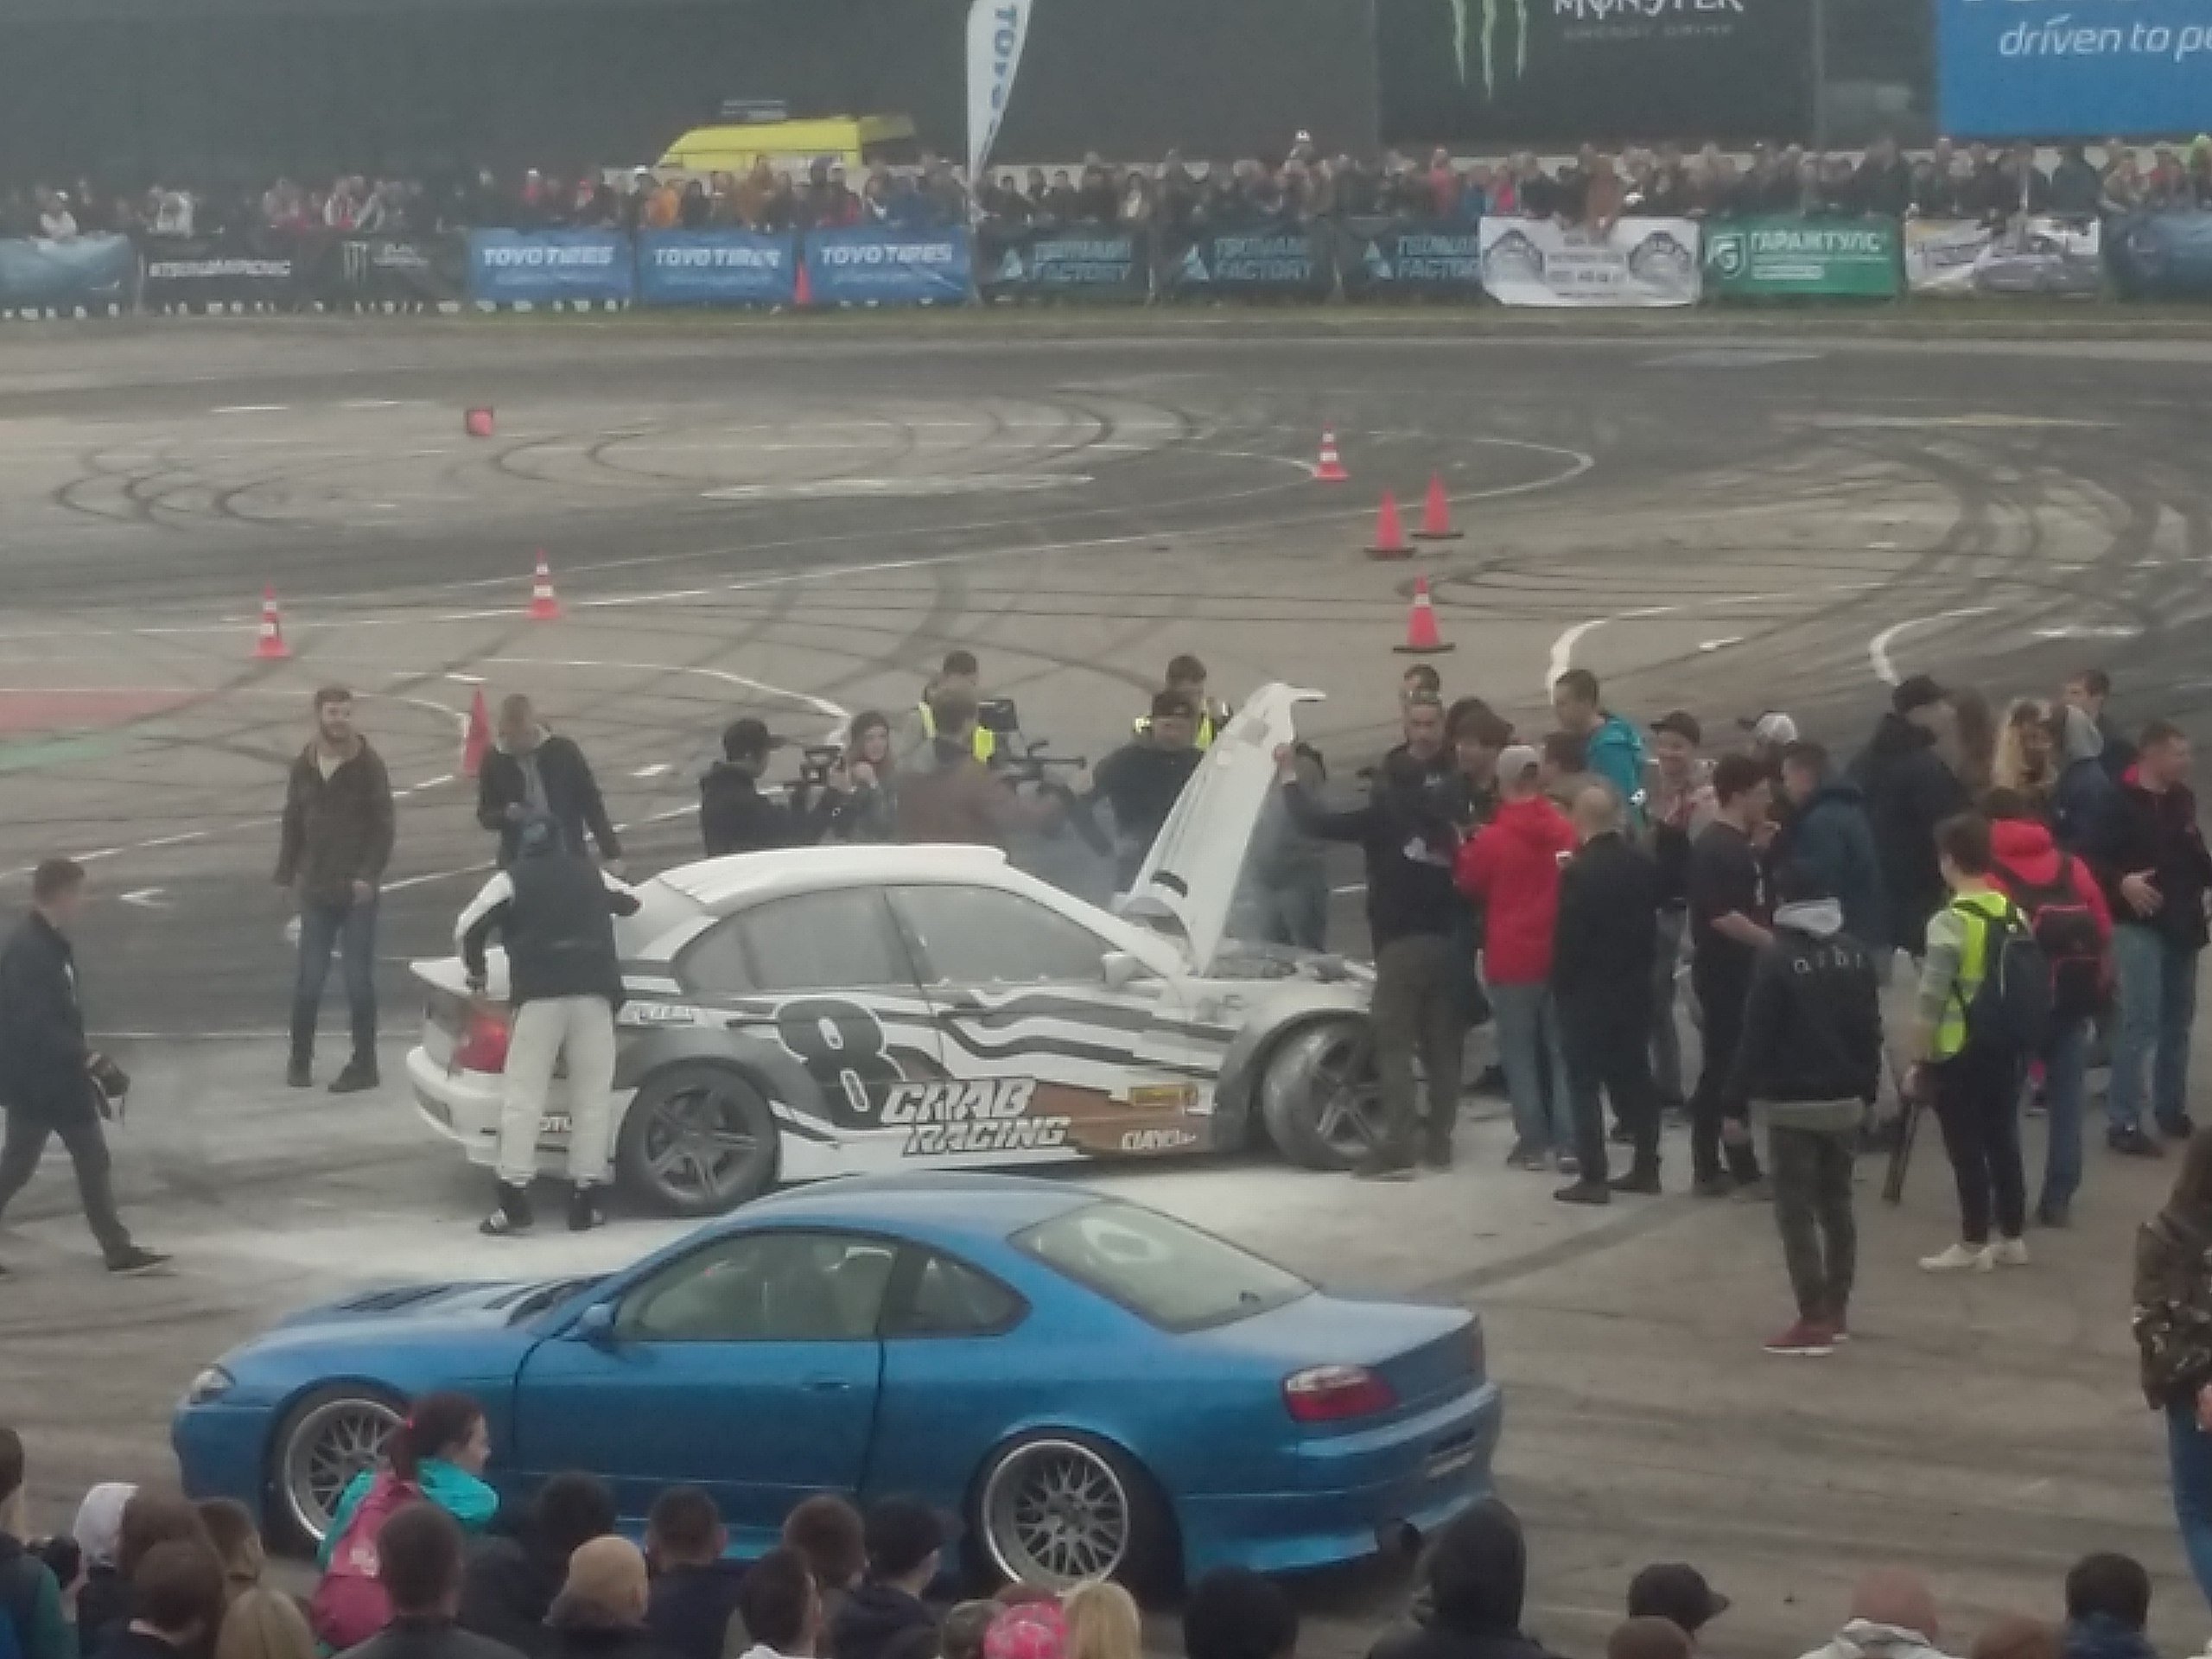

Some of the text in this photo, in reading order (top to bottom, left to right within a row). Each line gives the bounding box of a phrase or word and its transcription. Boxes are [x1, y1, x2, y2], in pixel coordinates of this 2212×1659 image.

[1999, 13, 2121, 55] driven
[2132, 22, 2170, 53] to
[822, 245, 880, 264] TOYO
[776, 995, 906, 1130] 8
[880, 1078, 1037, 1123] CRAB
[900, 1117, 1071, 1158] RACING
